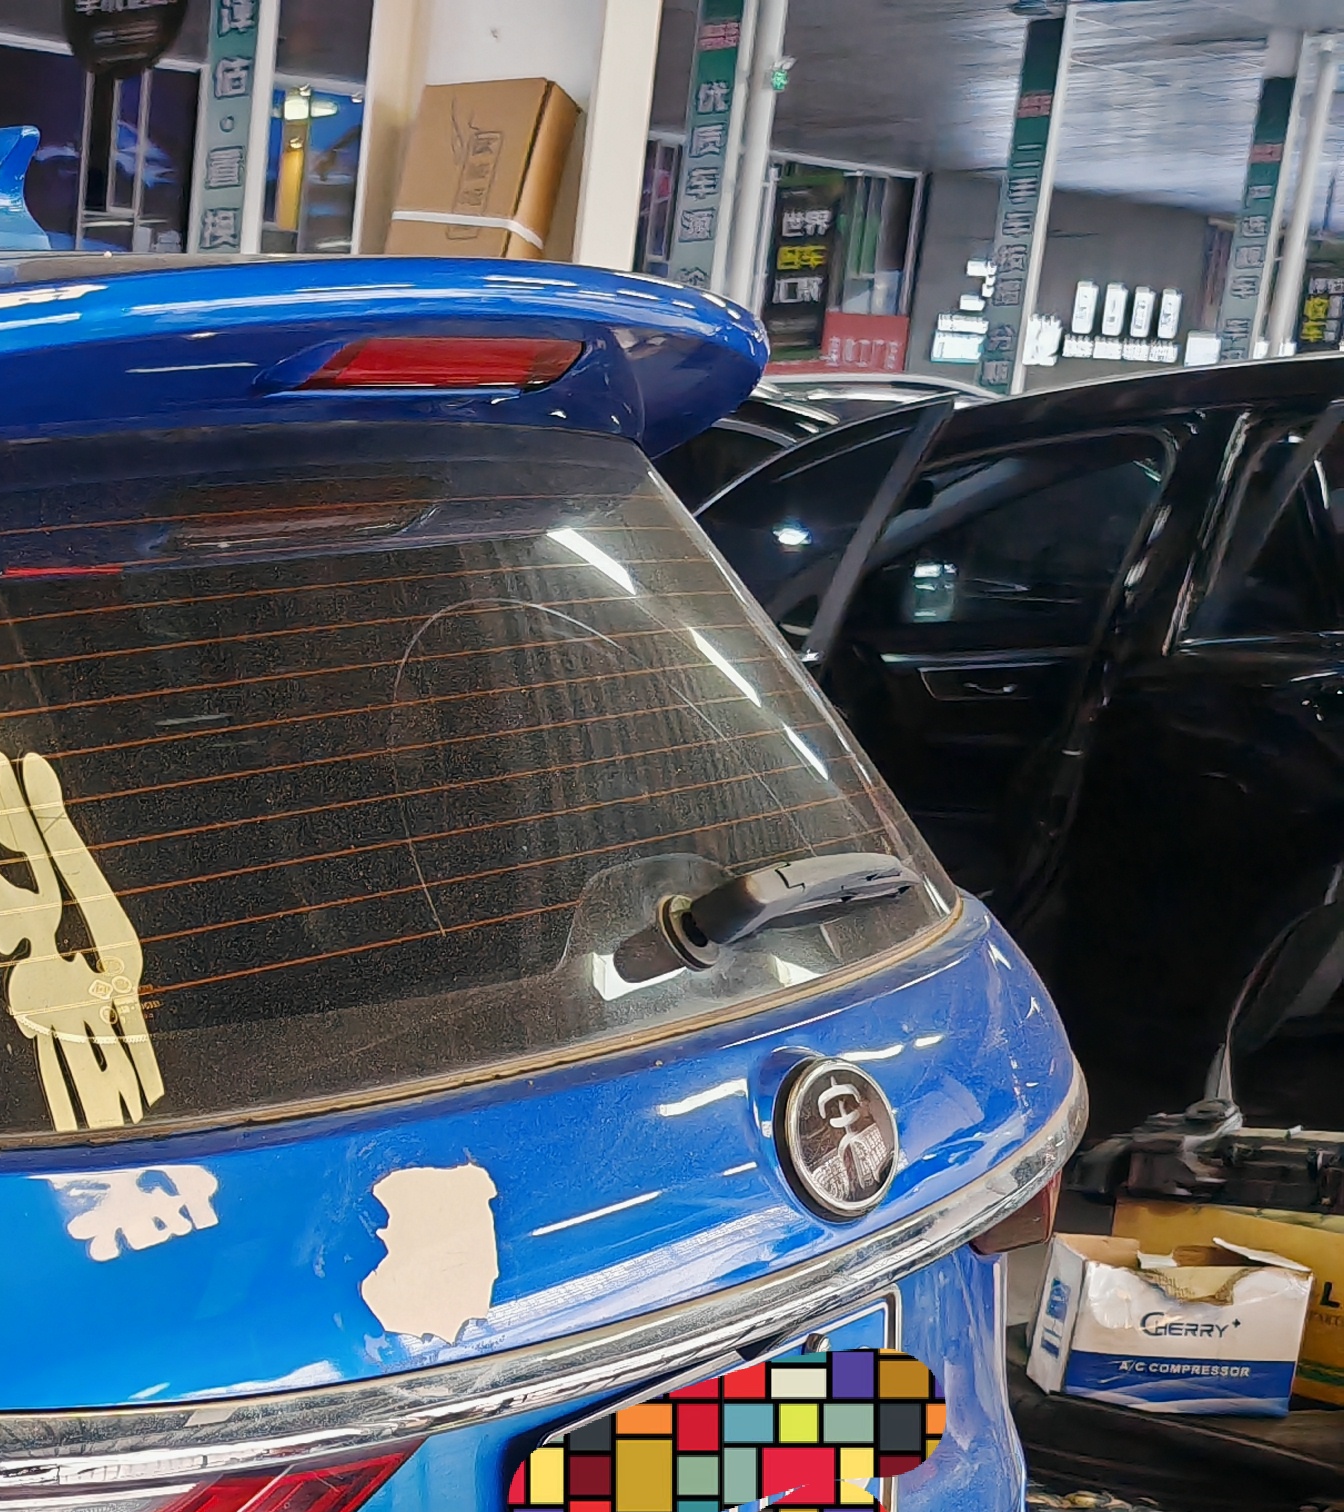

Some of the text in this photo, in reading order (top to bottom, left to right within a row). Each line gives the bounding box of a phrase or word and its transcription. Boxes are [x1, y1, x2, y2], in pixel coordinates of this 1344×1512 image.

[1140, 1311, 1230, 1339] CHERRY
[1118, 1359, 1251, 1378] A/C COMPRESSOR
